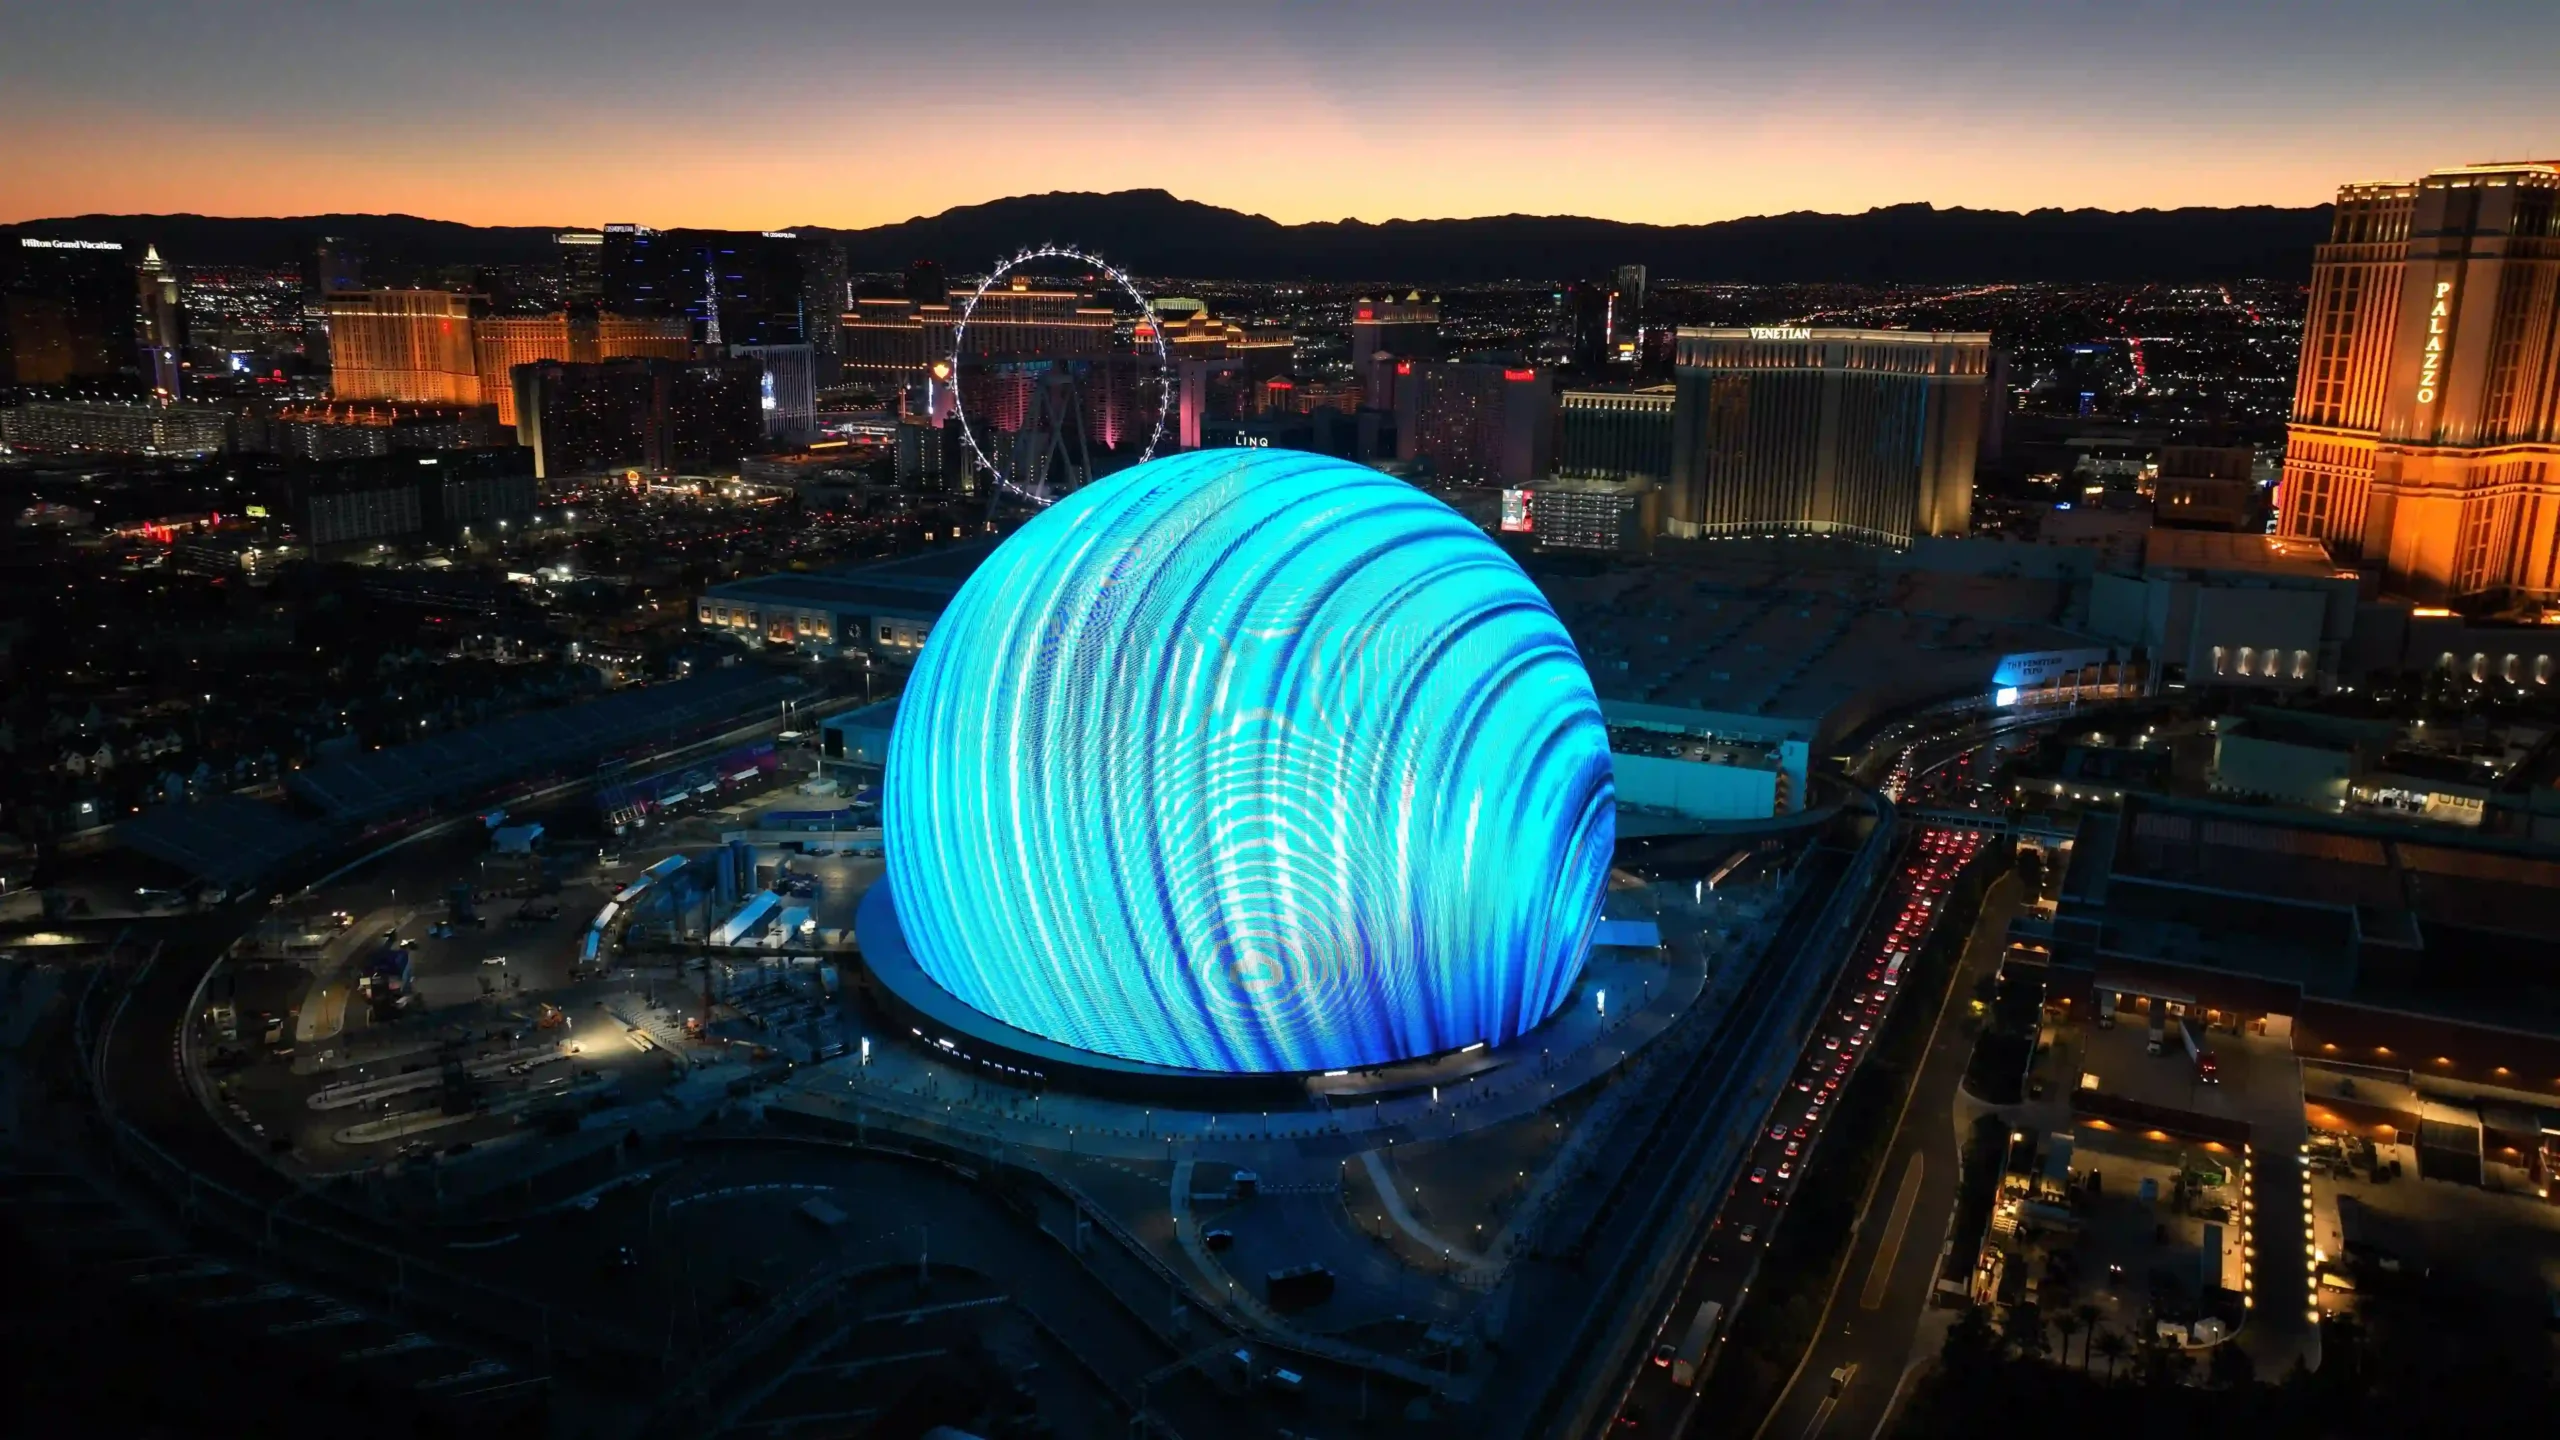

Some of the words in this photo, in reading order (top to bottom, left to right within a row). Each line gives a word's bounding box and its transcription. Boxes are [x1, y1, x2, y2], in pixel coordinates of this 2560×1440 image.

[21, 238, 52, 248] Hilton
[52, 239, 80, 249] Grand
[80, 240, 123, 250] Vacations
[1750, 327, 1812, 340] VENETIAN
[2417, 282, 2451, 404] PALAZZO
[1235, 436, 1269, 447] LINQ
[2007, 661, 2022, 670] THE
